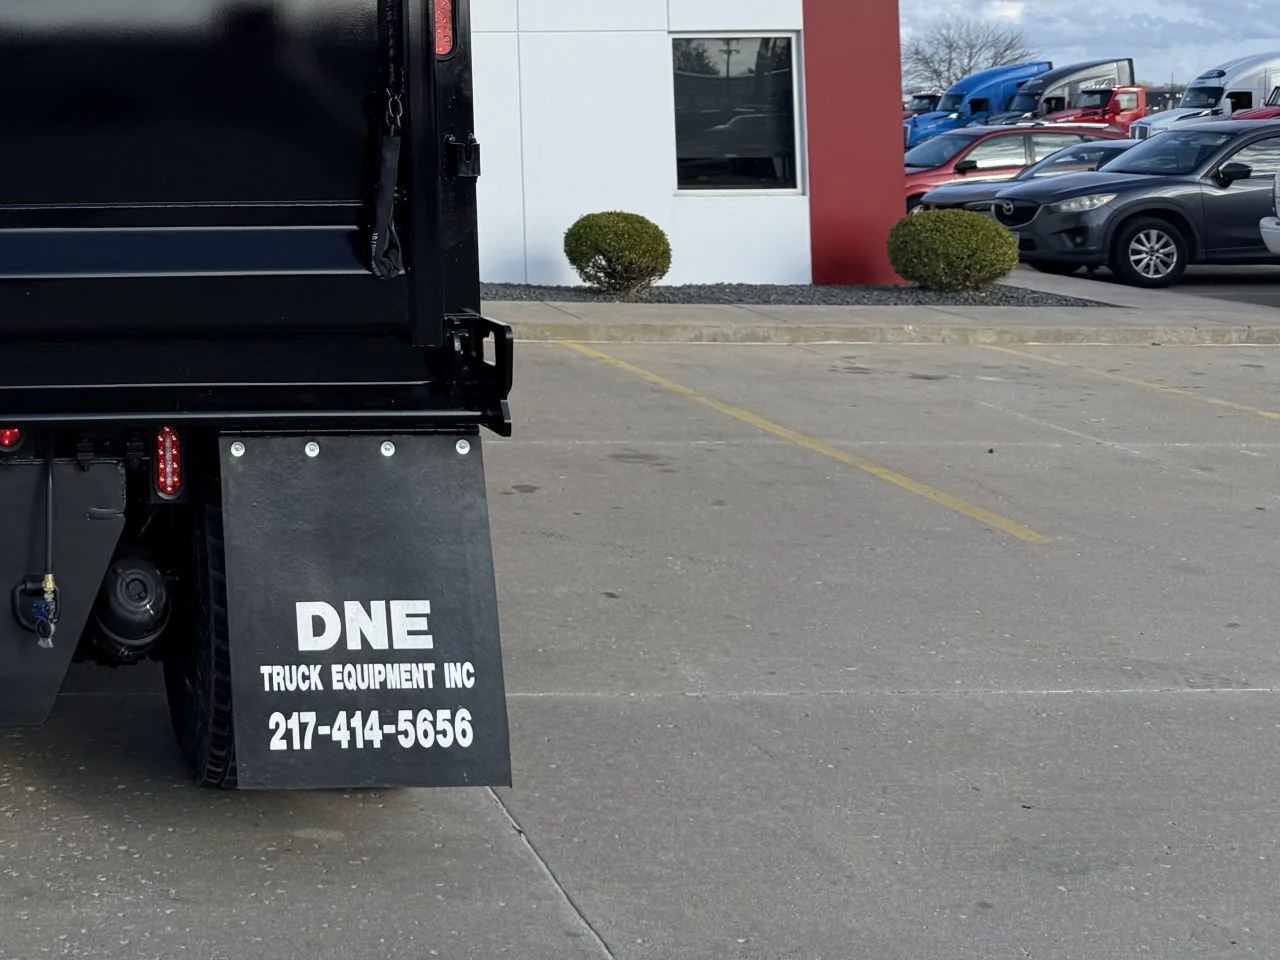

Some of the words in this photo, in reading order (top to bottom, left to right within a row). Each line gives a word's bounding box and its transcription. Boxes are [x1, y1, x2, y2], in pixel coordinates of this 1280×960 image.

[295, 600, 434, 652] DNE
[260, 664, 324, 692] TRUCK
[331, 662, 436, 691] EQUIPMENT
[443, 661, 476, 689] INC
[268, 707, 474, 751] 217-414-5656
